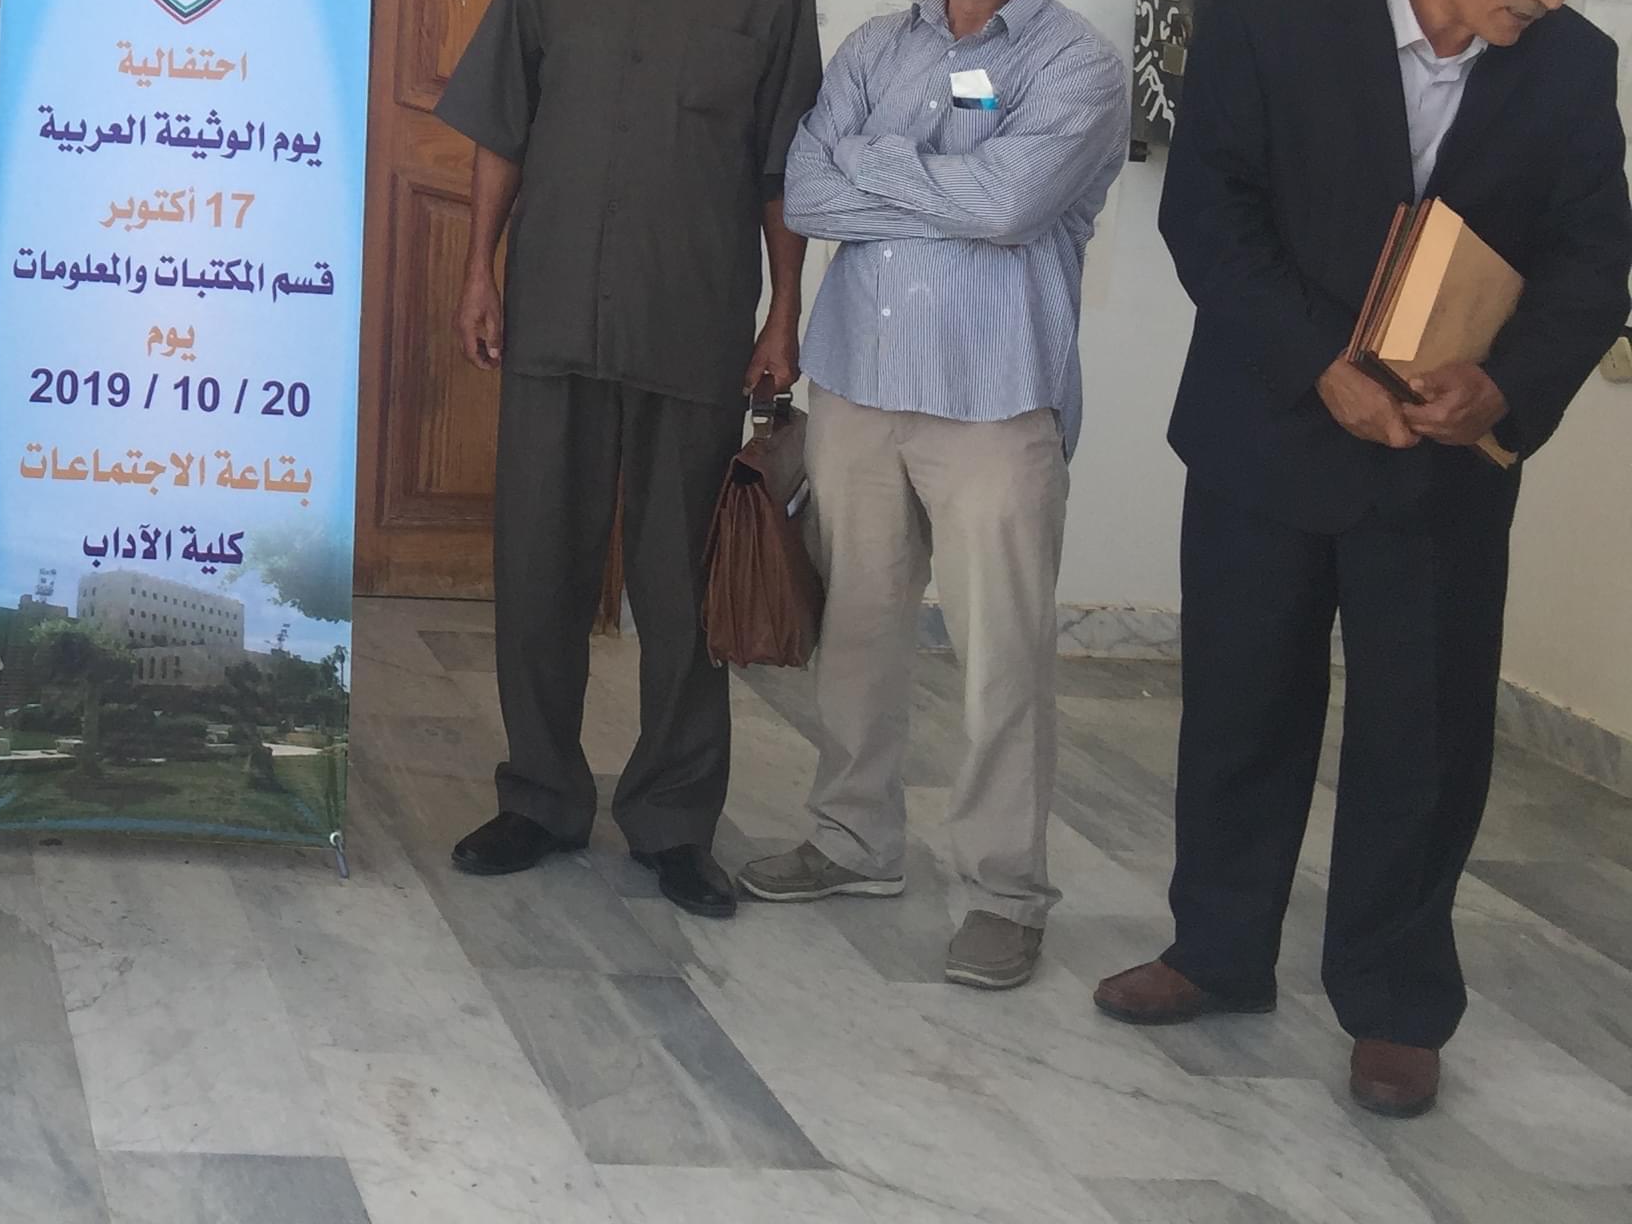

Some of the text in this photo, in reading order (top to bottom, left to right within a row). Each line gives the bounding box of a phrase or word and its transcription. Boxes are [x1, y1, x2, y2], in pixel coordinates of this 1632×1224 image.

[116, 39, 249, 89] احتفالية
[38, 104, 323, 169] يوم الوثيقة العربية
[99, 186, 256, 233] 17 أكتوبر
[12, 246, 336, 305] قسم المكتبات والمعلومات
[145, 323, 197, 364] يوم
[28, 367, 312, 419] 20 / 10 / 2019
[19, 441, 314, 509] بقاعة الاجتماعات
[82, 522, 246, 577] كلية الآداب
